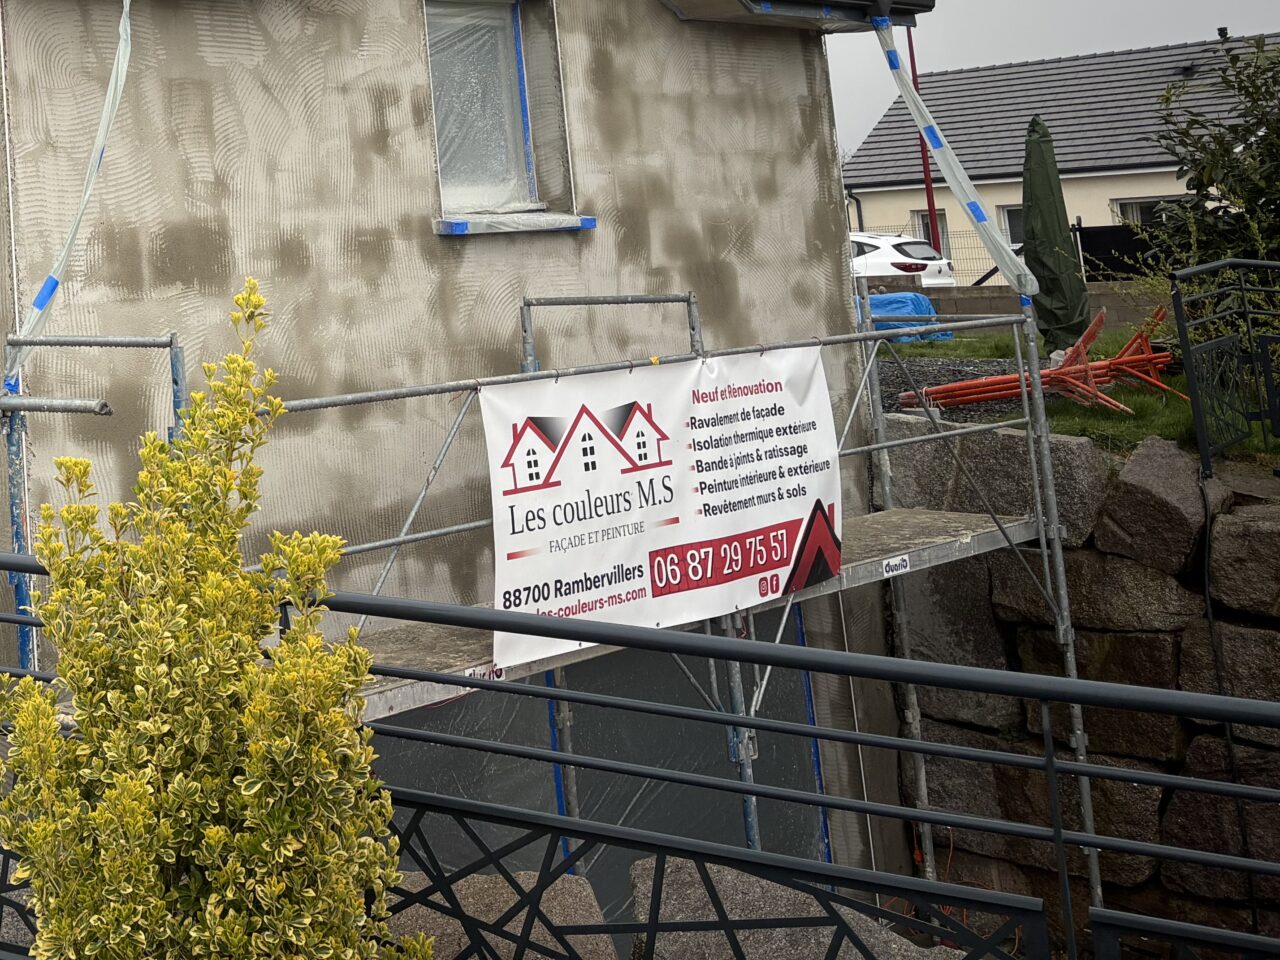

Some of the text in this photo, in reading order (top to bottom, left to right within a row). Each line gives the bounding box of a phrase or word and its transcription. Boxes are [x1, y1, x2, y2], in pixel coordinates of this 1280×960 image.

[692, 379, 783, 404] Neuf et Rénovation
[690, 403, 785, 430] Ravalement de façade
[692, 419, 818, 452] Isolation thermique extérieure
[696, 456, 728, 473] Bande
[733, 450, 755, 470] joints
[756, 448, 762, 461] &
[764, 443, 808, 460] ratissage
[699, 459, 831, 495] Peinture intérieure & extérieure
[508, 475, 674, 535] Les couleurs M.S
[703, 483, 807, 517] Revêtement murs & sols
[549, 520, 645, 553] FAÇADE ET PEINTURE
[654, 529, 787, 588] 06 87 29 75 57
[502, 563, 644, 609] 88700 Rambervillers
